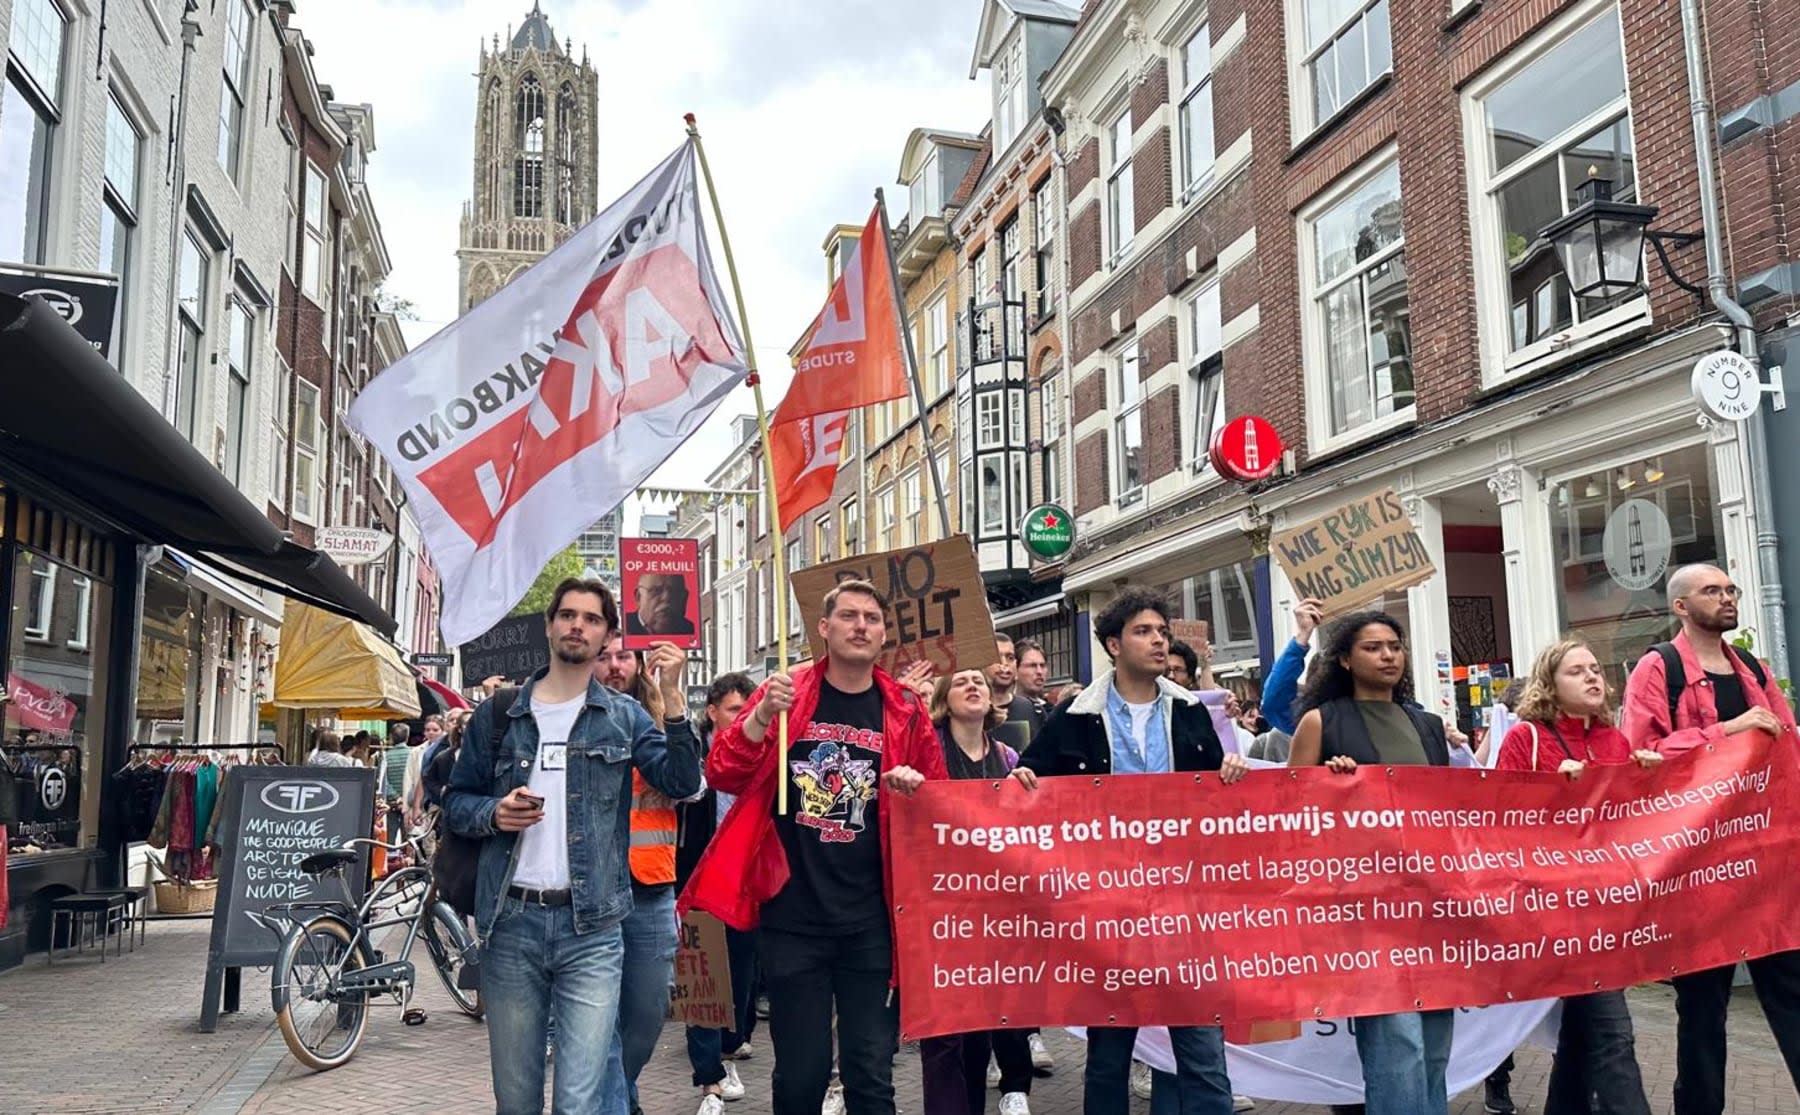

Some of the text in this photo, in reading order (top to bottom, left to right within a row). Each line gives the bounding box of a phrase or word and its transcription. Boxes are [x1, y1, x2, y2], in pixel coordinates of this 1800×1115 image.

[1707, 357, 1752, 379] NUMBER
[1721, 370, 1741, 400] 9
[1718, 401, 1748, 413] NINE
[1030, 532, 1070, 541] Heineken
[1278, 526, 1327, 567] WIE
[1375, 490, 1403, 523] IS
[324, 537, 378, 551] SLAMAT
[637, 543, 684, 555] €3000,-?
[625, 561, 694, 572] OP JE MUIL!
[1294, 565, 1343, 600] MAG
[1335, 542, 1391, 589] SLIM
[933, 765, 1771, 852] Toegang tot hoger onderwijs voor mensen met een functiebeperking/
[932, 808, 1771, 899] zonder rijke ouders/ met laagopgeleide ouders/ die van het mbo komen/
[932, 858, 1758, 941] die keihard moeten werken naast hun studie/ die te veel huur moeten
[934, 921, 1673, 991] betalen/ die geen tijd hebben voor een bijbaan/ en de rest...
